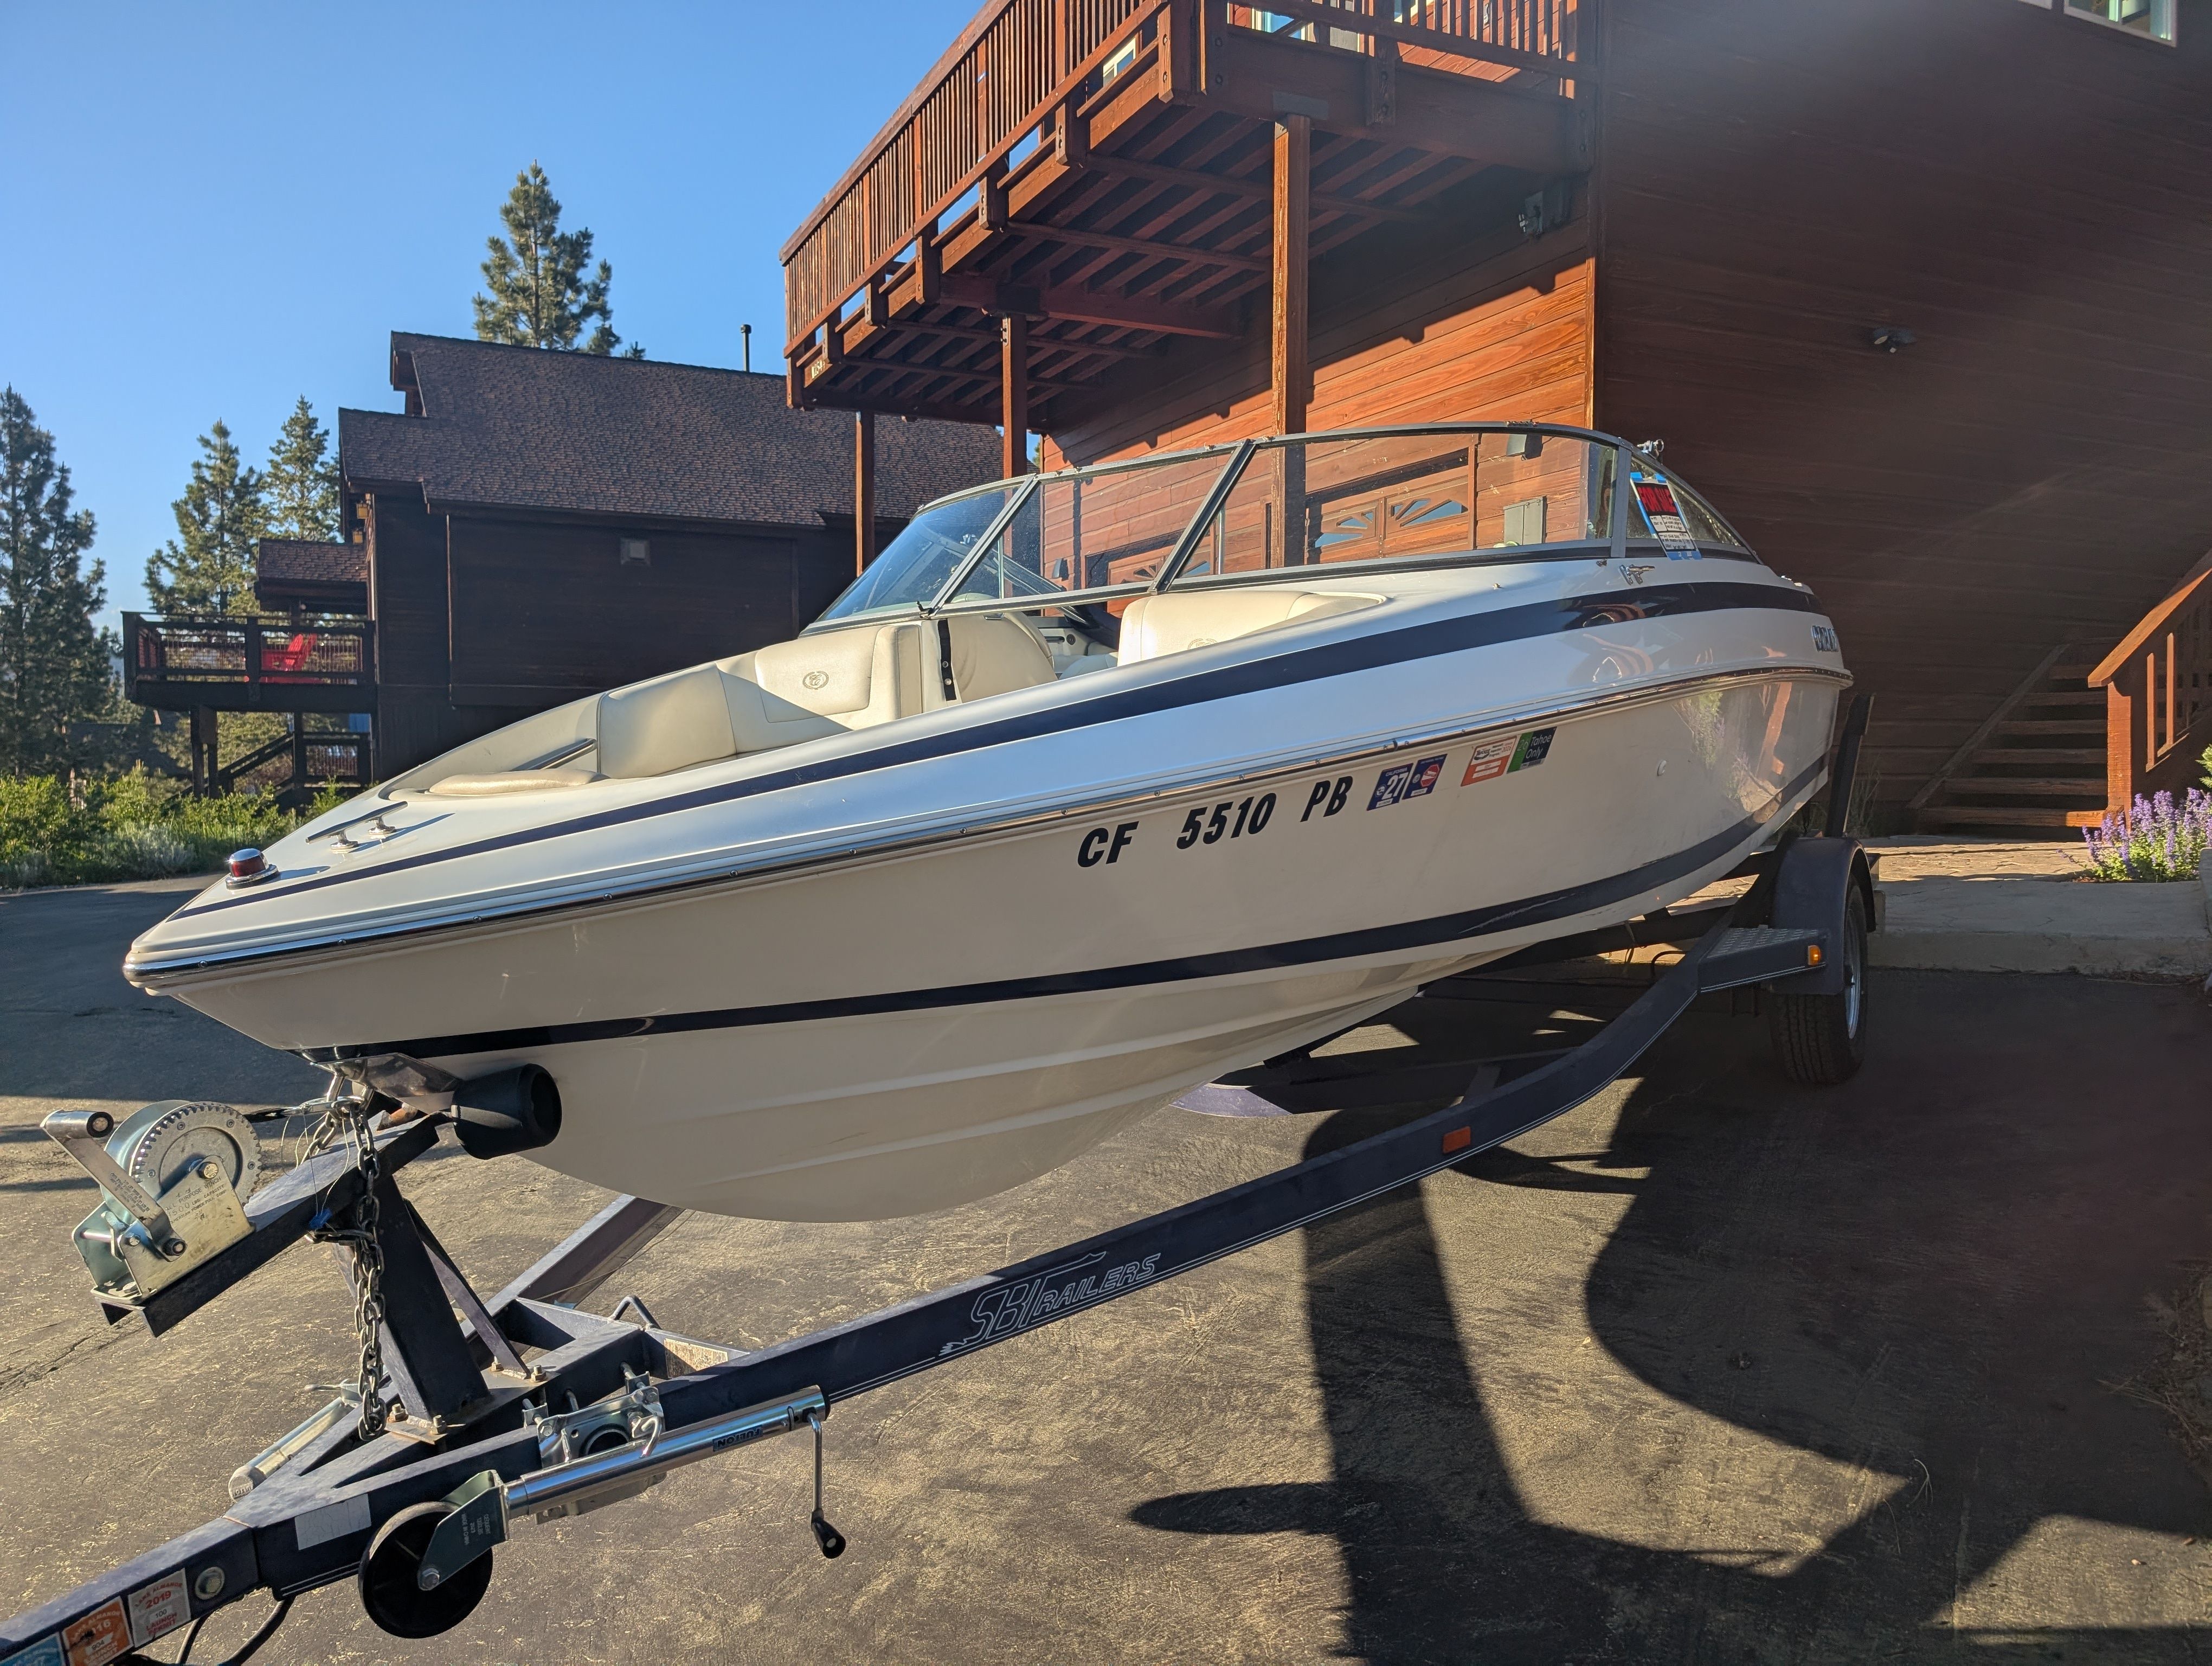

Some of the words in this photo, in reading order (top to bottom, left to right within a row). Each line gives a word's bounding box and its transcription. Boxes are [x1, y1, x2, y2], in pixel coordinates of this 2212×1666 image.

[1531, 734, 1552, 747] Tahoe
[1526, 747, 1543, 759] Only
[1385, 767, 1407, 777] CALIFORNIA
[1381, 772, 1409, 800] 27
[1077, 821, 1139, 868] CF
[1176, 793, 1277, 849] 5510
[1300, 776, 1354, 822] PB
[179, 1187, 203, 1203] PURPOSE
[204, 1176, 221, 1189] WINCH
[717, 1427, 761, 1447] FULTON
[145, 1590, 172, 1609] 2019
[146, 1612, 178, 1631] LAUNCH
